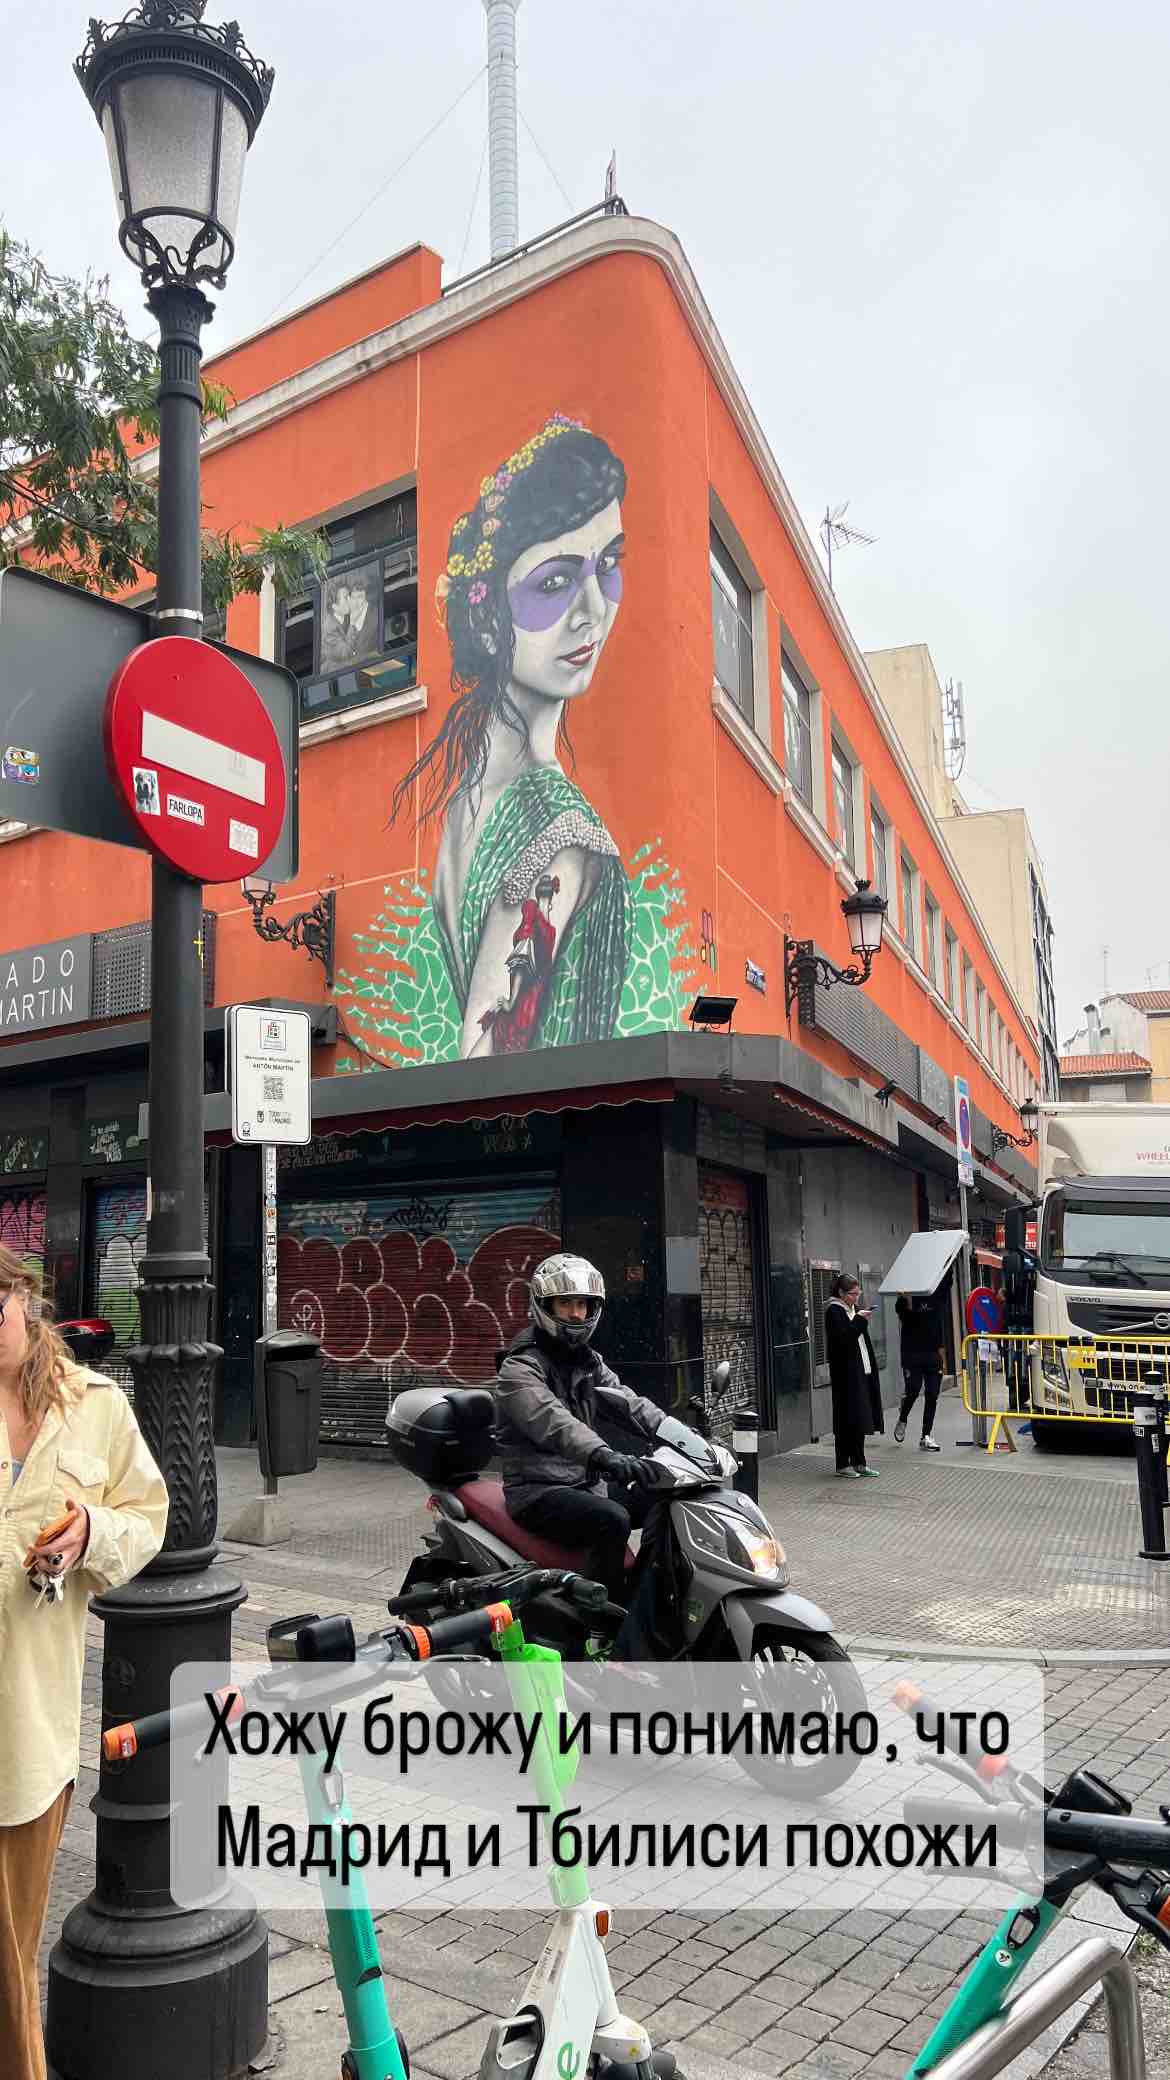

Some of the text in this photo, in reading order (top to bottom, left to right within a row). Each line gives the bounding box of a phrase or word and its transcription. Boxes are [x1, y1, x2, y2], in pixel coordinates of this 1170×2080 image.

[169, 799, 203, 820] FARLOPA
[0, 984, 74, 1025] ARTIN
[1071, 1296, 1103, 1304] VOLVO
